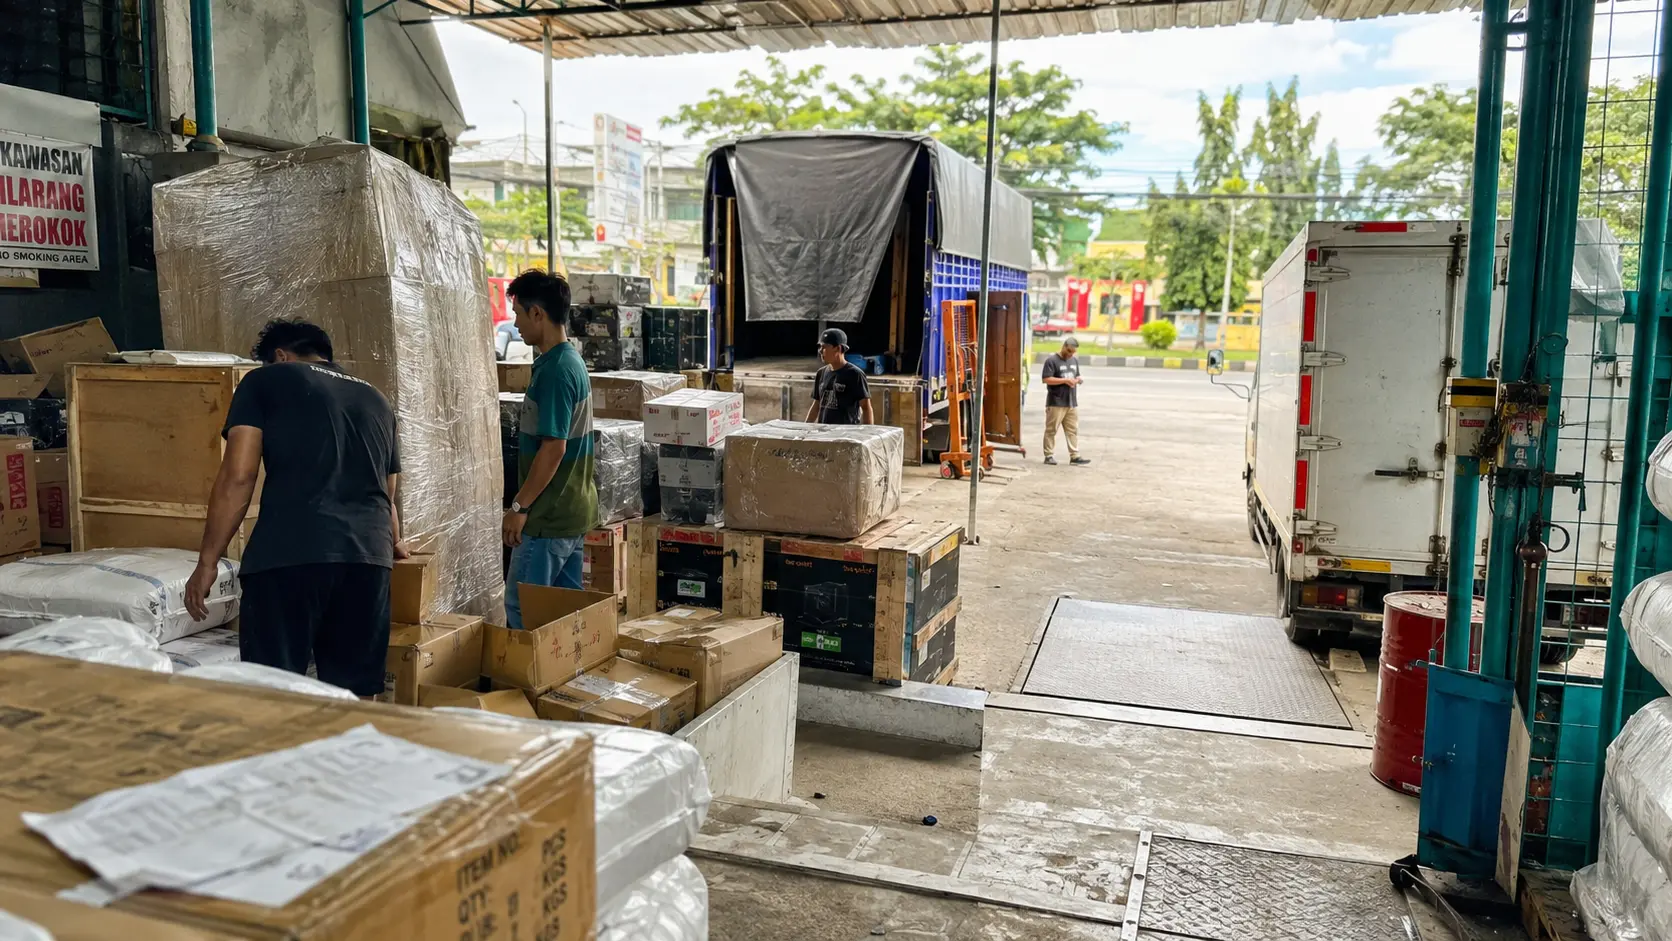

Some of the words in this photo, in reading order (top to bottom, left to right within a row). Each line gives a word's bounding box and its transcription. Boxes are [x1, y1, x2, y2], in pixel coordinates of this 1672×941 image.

[0, 141, 84, 176] KAWASAN
[0, 251, 10, 260] O
[13, 252, 60, 263] SMOKING
[62, 255, 89, 264] AREA
[542, 827, 567, 864] PCS
[456, 847, 494, 893] ITEM
[542, 854, 567, 891] KGS
